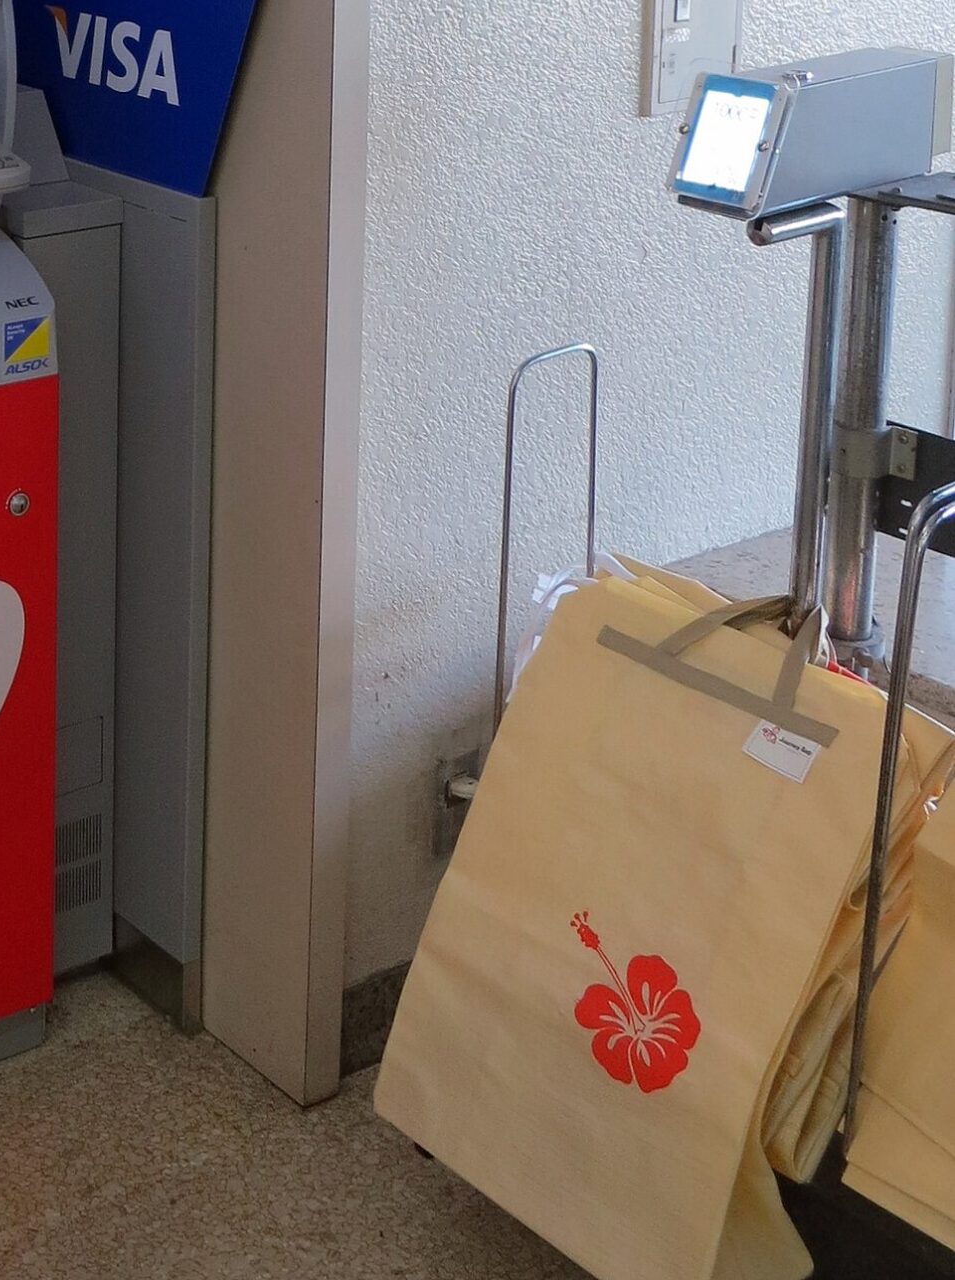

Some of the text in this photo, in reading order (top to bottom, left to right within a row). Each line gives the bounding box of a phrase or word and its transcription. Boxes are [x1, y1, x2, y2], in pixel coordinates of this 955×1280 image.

[44, 4, 180, 106] VISA
[5, 296, 39, 309] NEC
[5, 357, 49, 375] ALSOK
